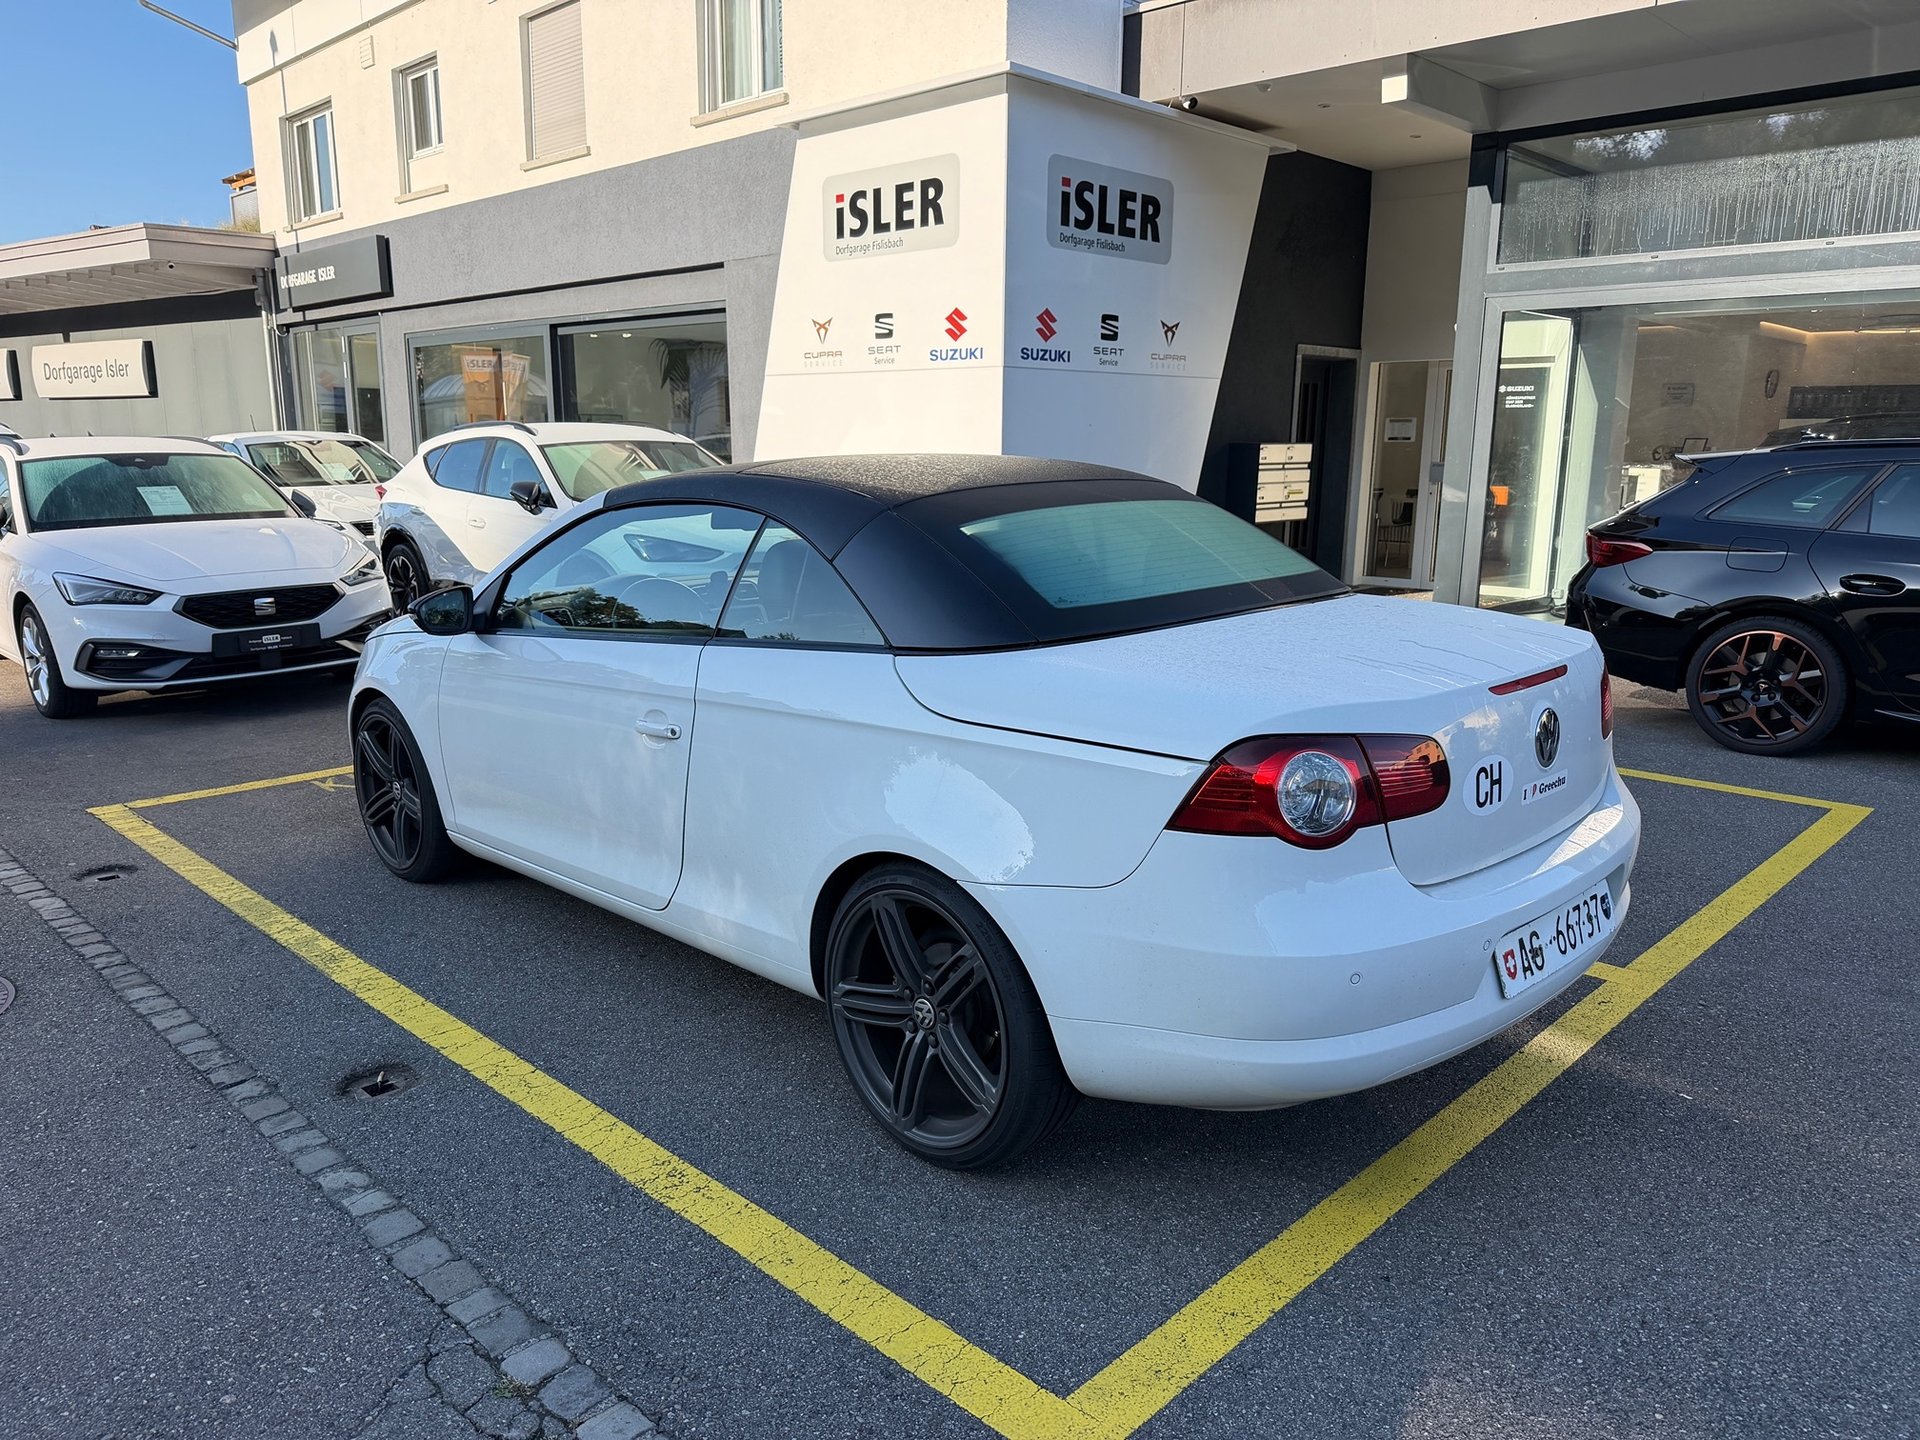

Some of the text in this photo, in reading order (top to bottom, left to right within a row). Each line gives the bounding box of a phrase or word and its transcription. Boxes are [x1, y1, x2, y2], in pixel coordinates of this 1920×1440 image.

[836, 177, 944, 239] iSLER
[1061, 176, 1161, 243] iSLER
[835, 237, 904, 256] Dorfgarage Fislisbach
[1060, 232, 1125, 252] Dorfgarage Fislisbach
[280, 265, 336, 289] DORFGARAGE ISLER
[804, 350, 843, 359] CUPRA
[868, 345, 901, 355] SEAT
[929, 347, 983, 361] SUZUKI
[1020, 347, 1071, 363] SUZUKI
[1093, 346, 1125, 356] SEAT
[1151, 353, 1186, 362] CUPRA
[804, 359, 843, 368] SERVICE
[874, 357, 895, 365] Service
[1099, 358, 1118, 367] Service
[1150, 362, 1186, 371] SERVICE
[43, 358, 129, 384] Dorfgarage Isler
[1475, 761, 1502, 809] CH
[1518, 893, 1601, 980] AG 66737
